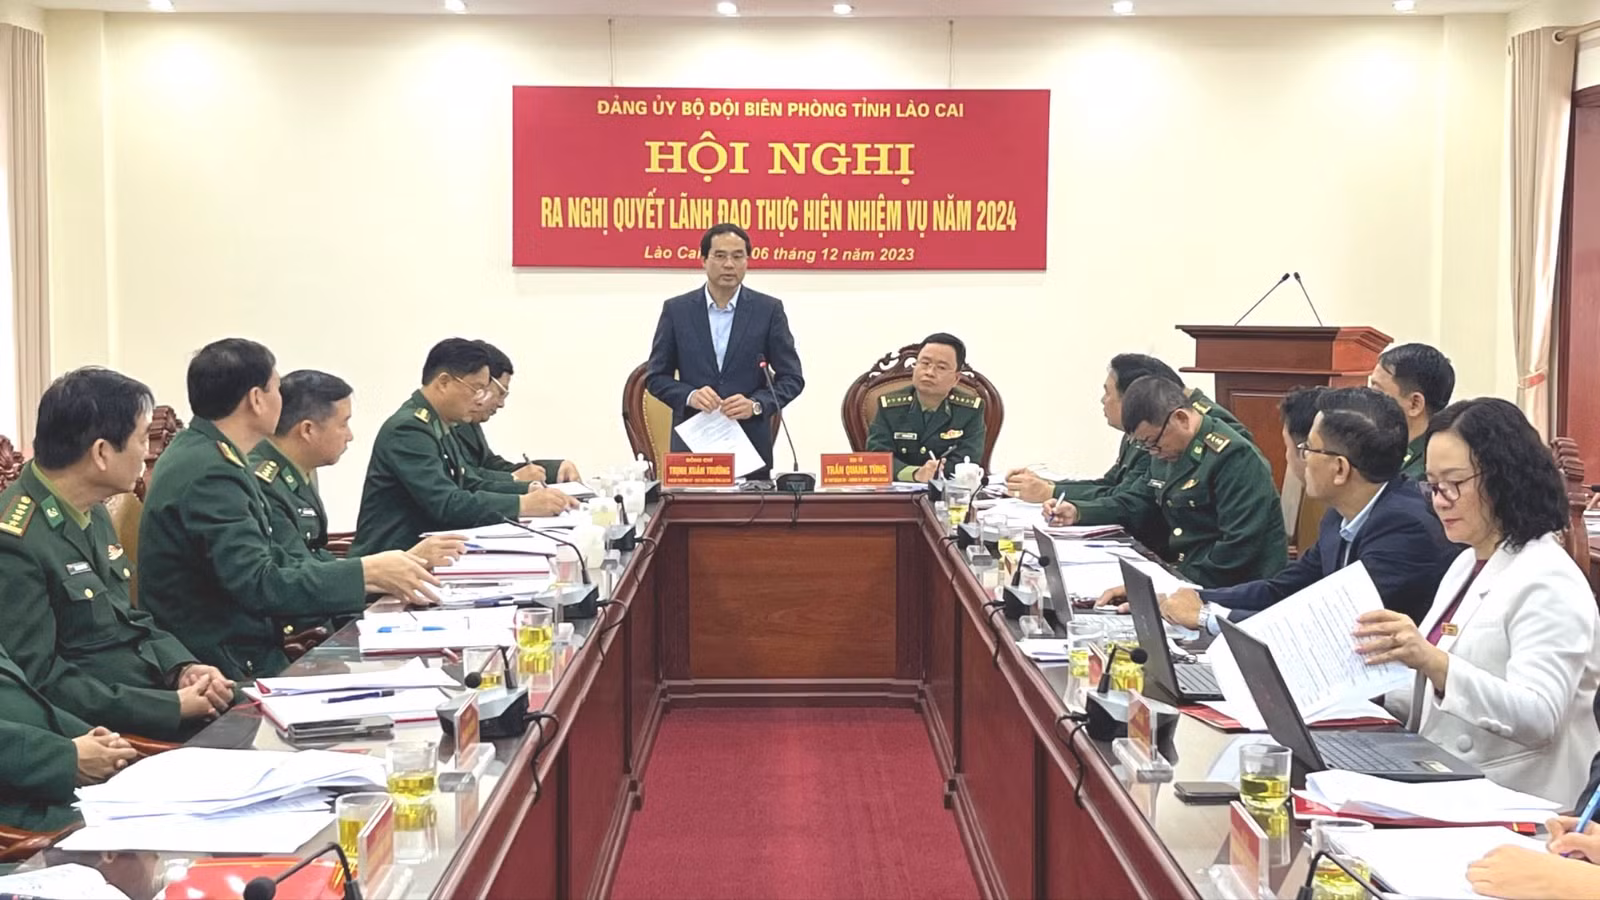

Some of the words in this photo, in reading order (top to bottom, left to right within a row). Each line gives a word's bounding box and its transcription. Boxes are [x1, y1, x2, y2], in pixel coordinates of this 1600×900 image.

[597, 94, 648, 115] ĐẢNG
[652, 94, 677, 116] ỦY
[681, 97, 705, 121] BỘ
[709, 97, 740, 121] ĐỘI
[744, 98, 783, 117] BIÊN
[787, 98, 847, 118] PHÒNG
[851, 96, 891, 118] TỈNH
[895, 99, 930, 118] LÀO
[934, 102, 964, 118] CAI
[644, 130, 749, 183] HỘI
[767, 142, 915, 186] NGHỊ
[541, 196, 564, 228] RA
[567, 196, 608, 236] NGHỊ
[613, 187, 665, 233] QUYẾT
[669, 192, 713, 230] LÃNH
[755, 196, 799, 237] THỰC
[803, 192, 843, 238] HIỆN
[847, 192, 902, 239] NHIỆM
[906, 199, 928, 239] VỤ
[932, 193, 972, 231] NĂM
[976, 200, 1017, 231] 2024
[644, 246, 673, 260] Lào
[677, 246, 702, 260] Cai
[751, 246, 769, 260] 06
[773, 247, 816, 264] tháng
[821, 248, 838, 261] 12
[842, 249, 875, 261] năm
[879, 248, 915, 261] 2023
